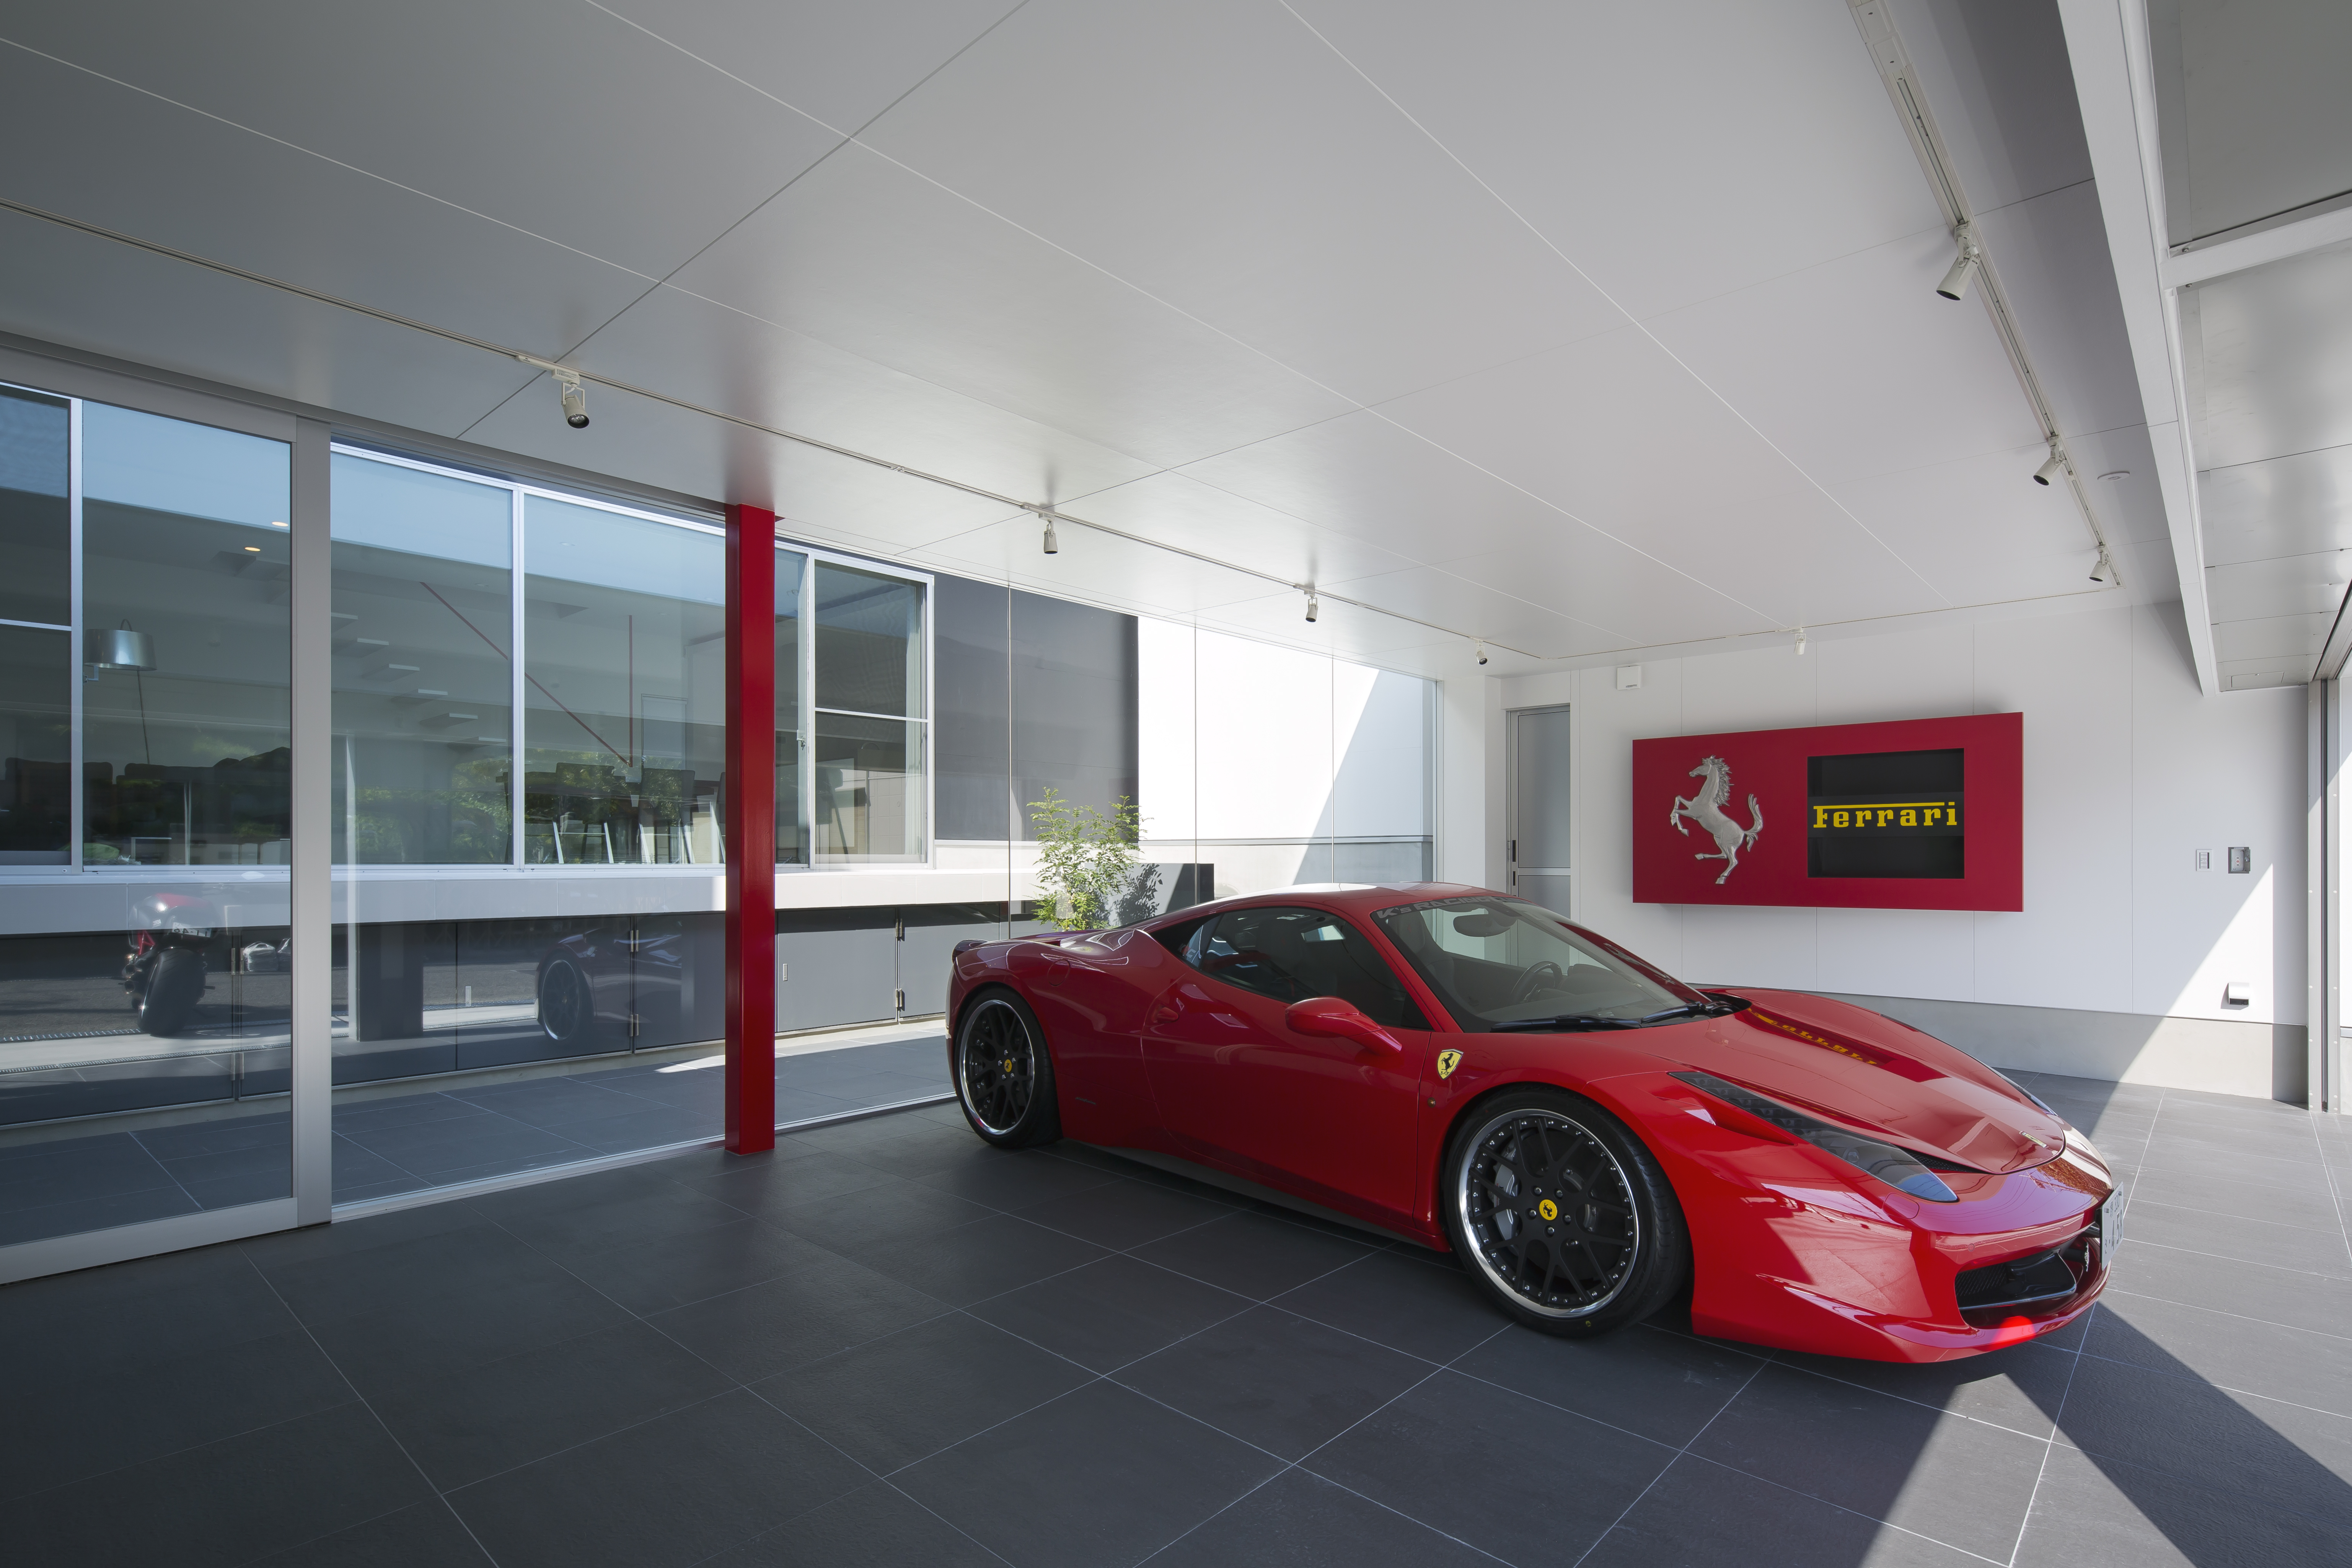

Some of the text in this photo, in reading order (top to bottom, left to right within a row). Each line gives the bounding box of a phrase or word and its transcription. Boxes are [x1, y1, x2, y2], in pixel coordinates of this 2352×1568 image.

[1813, 802, 1957, 828] Ferrari
[1377, 907, 1412, 918] K's
[1413, 896, 1491, 910] RACING
